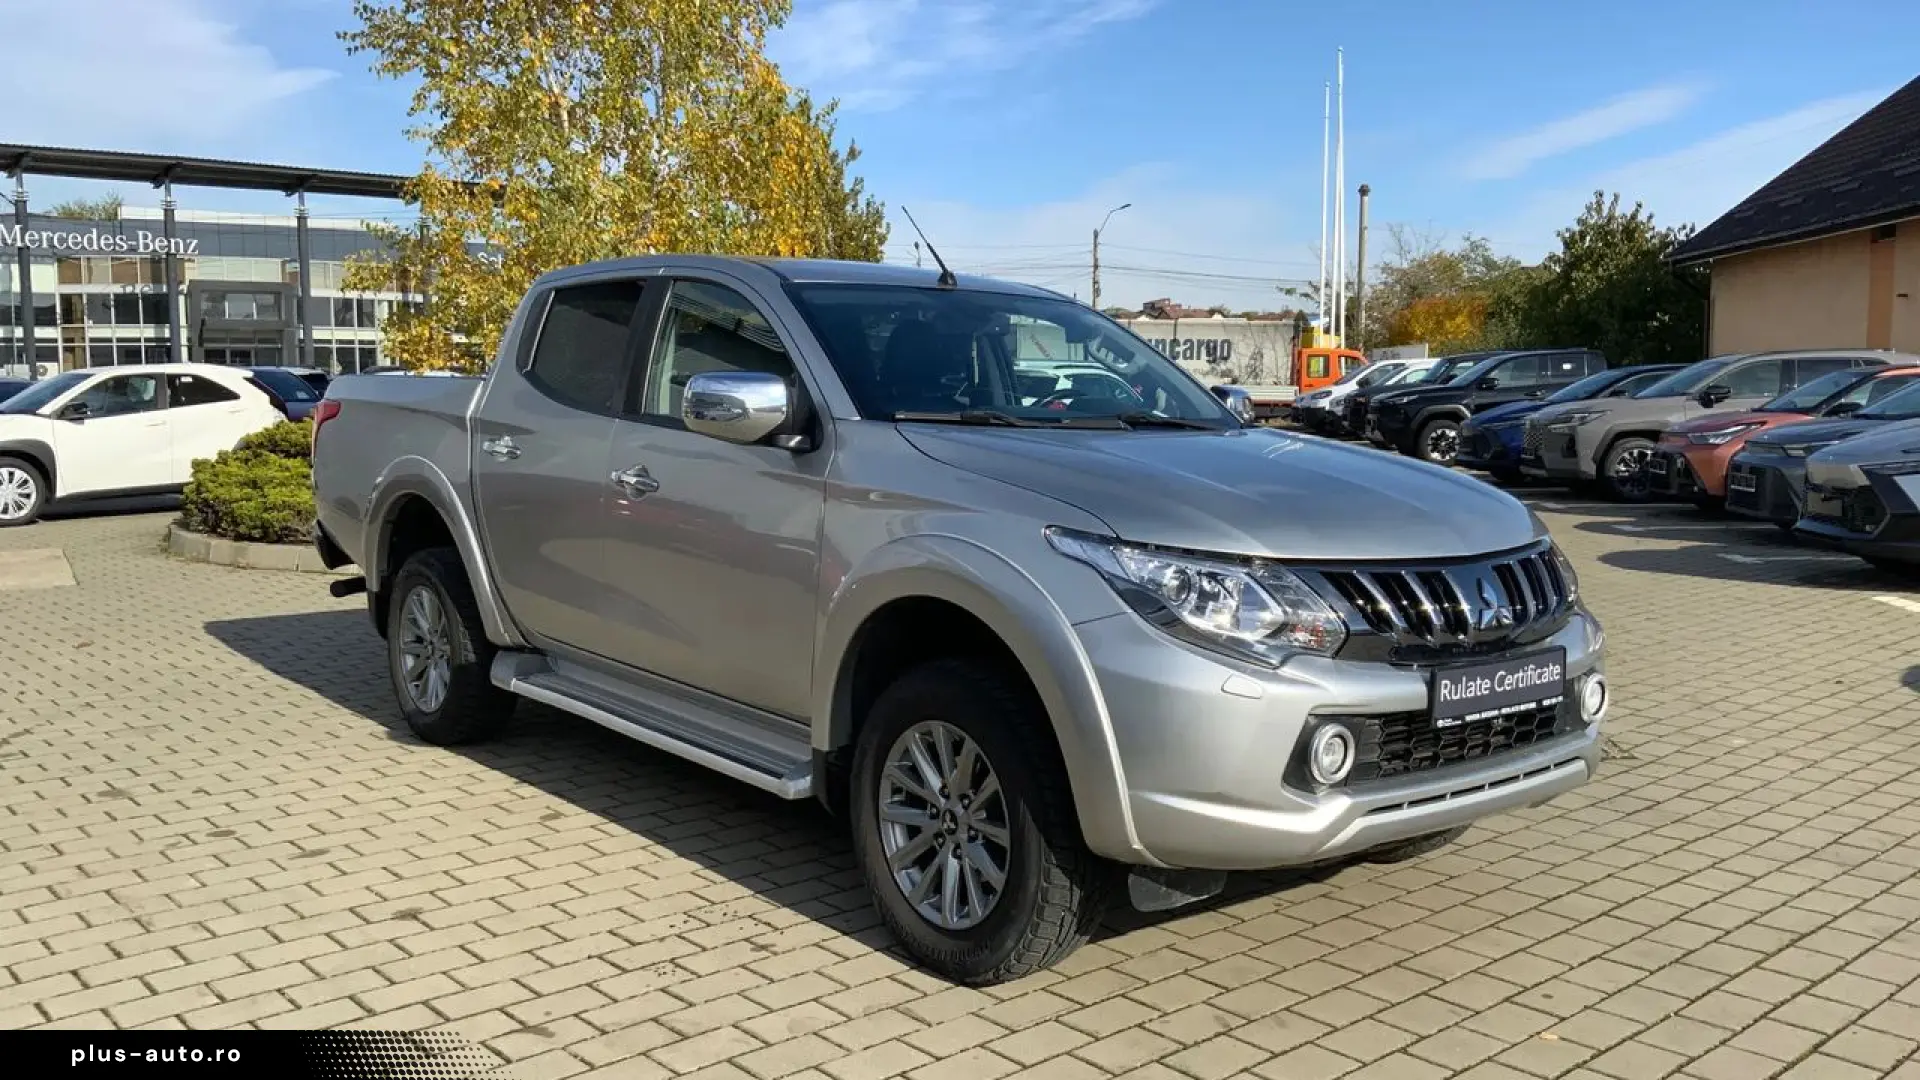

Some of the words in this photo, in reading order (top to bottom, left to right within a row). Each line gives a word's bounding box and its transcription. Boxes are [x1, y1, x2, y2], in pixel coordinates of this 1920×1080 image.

[0, 224, 199, 255] Mercedes-Benz
[1440, 675, 1491, 702] Rulate
[1494, 663, 1561, 692] Certificate
